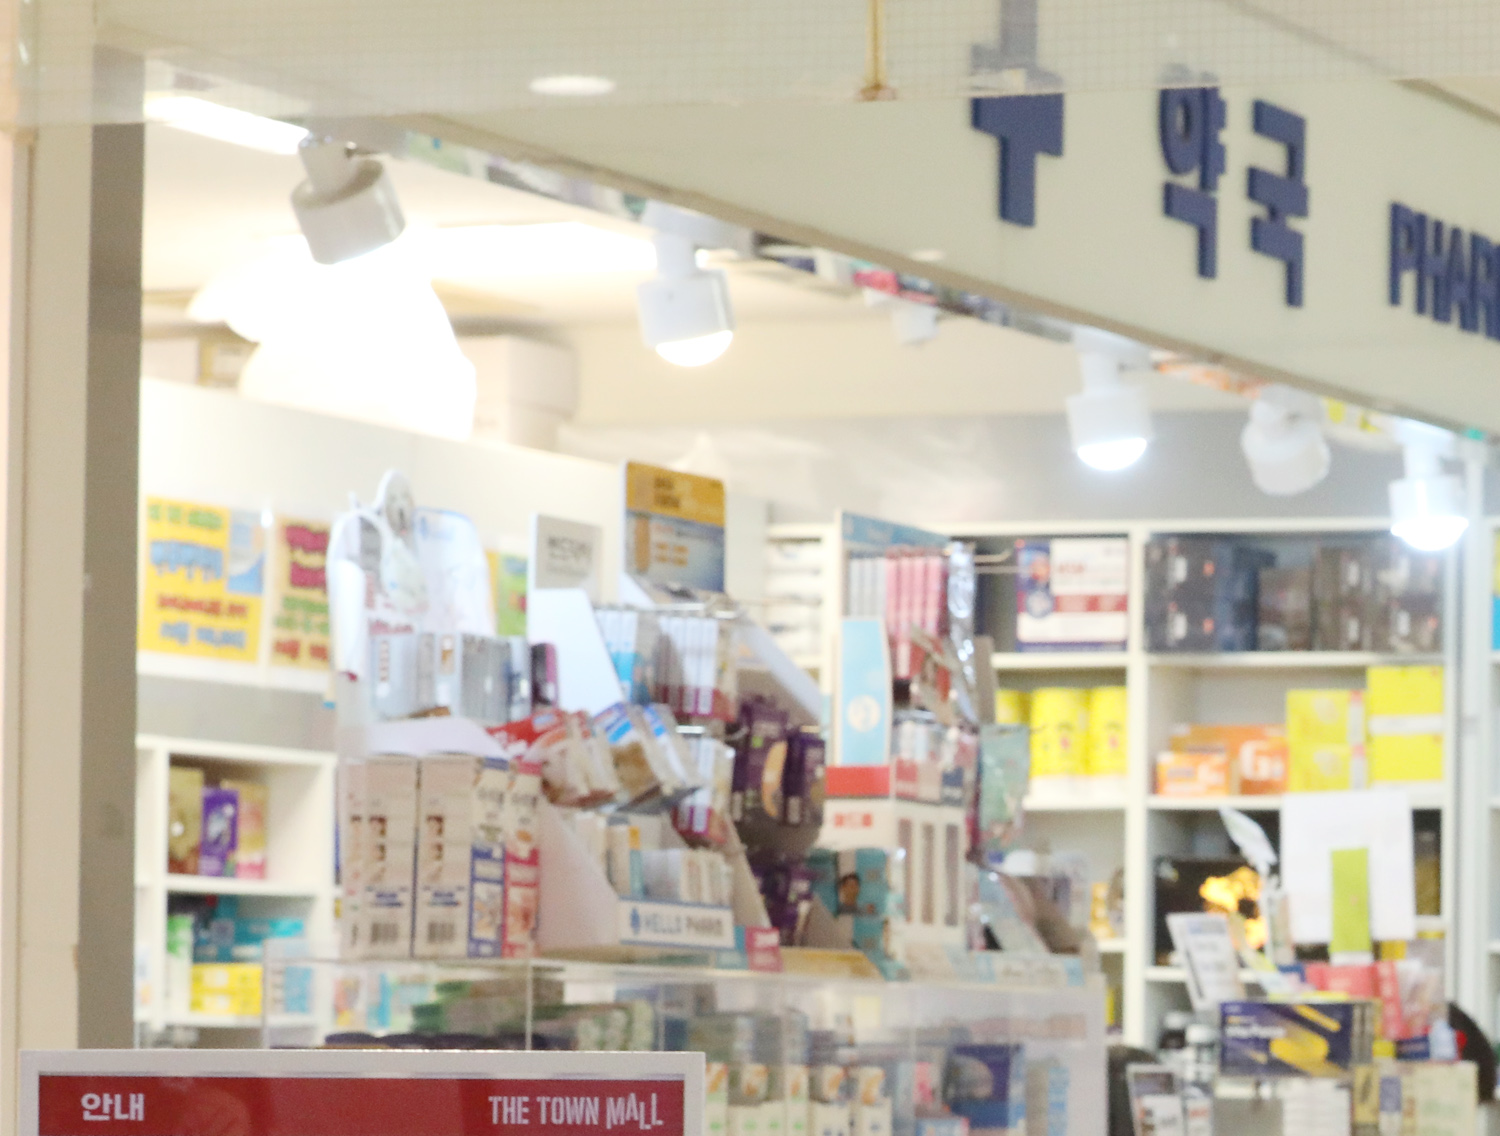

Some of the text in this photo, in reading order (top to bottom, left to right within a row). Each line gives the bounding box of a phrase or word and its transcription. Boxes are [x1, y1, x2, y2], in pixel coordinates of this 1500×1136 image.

[1155, 65, 1310, 309] 약국
[80, 1092, 145, 1122] 안내
[488, 1092, 664, 1130] THE TOWN MALL
